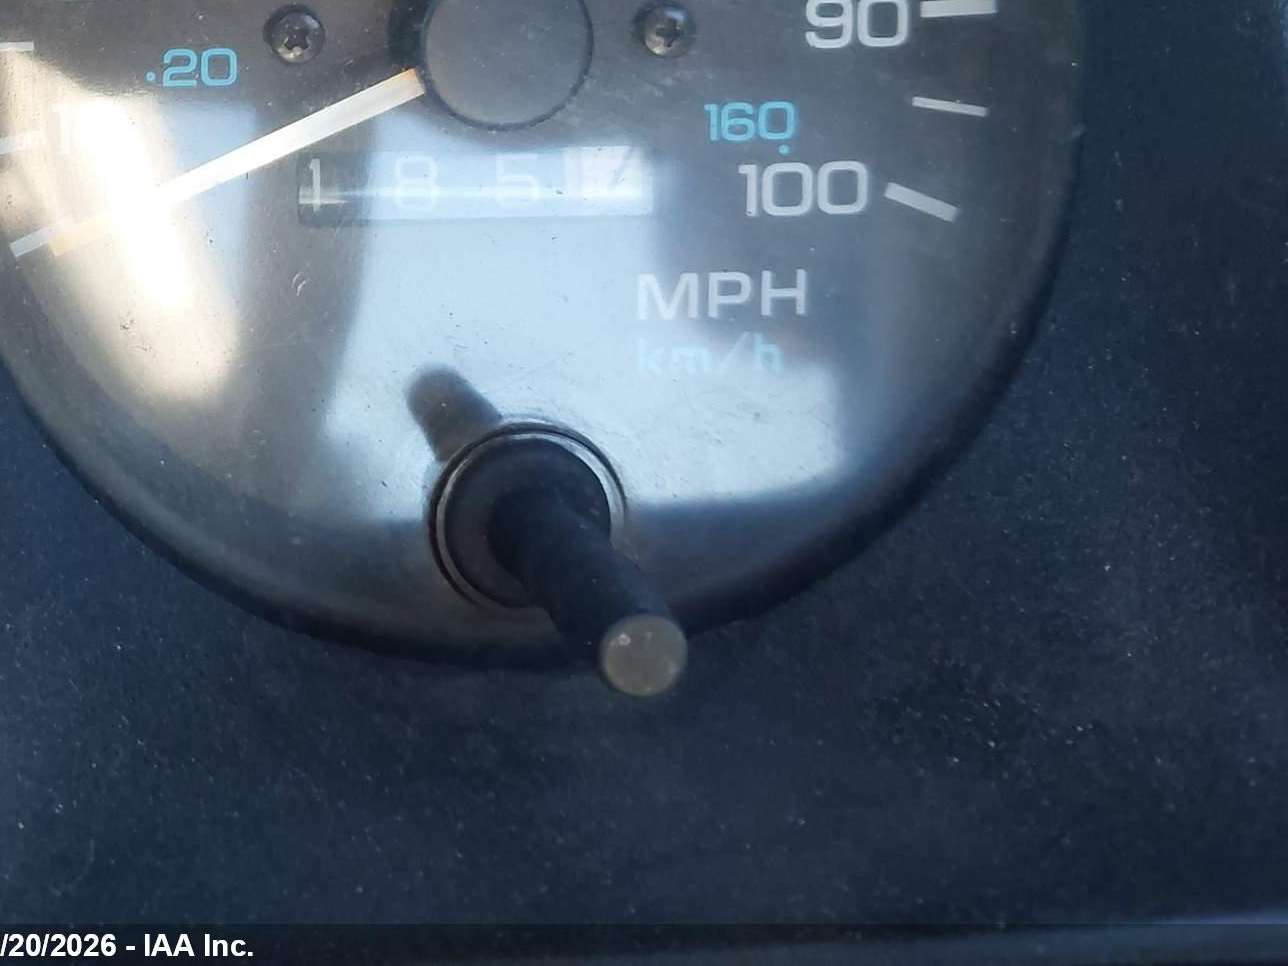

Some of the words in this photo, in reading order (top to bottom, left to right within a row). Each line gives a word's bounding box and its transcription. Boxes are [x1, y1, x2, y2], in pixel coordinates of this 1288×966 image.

[162, 47, 238, 87] 20
[703, 101, 796, 142] 160
[738, 160, 869, 218] 100
[635, 268, 808, 321] MPH
[637, 332, 783, 376] km/h
